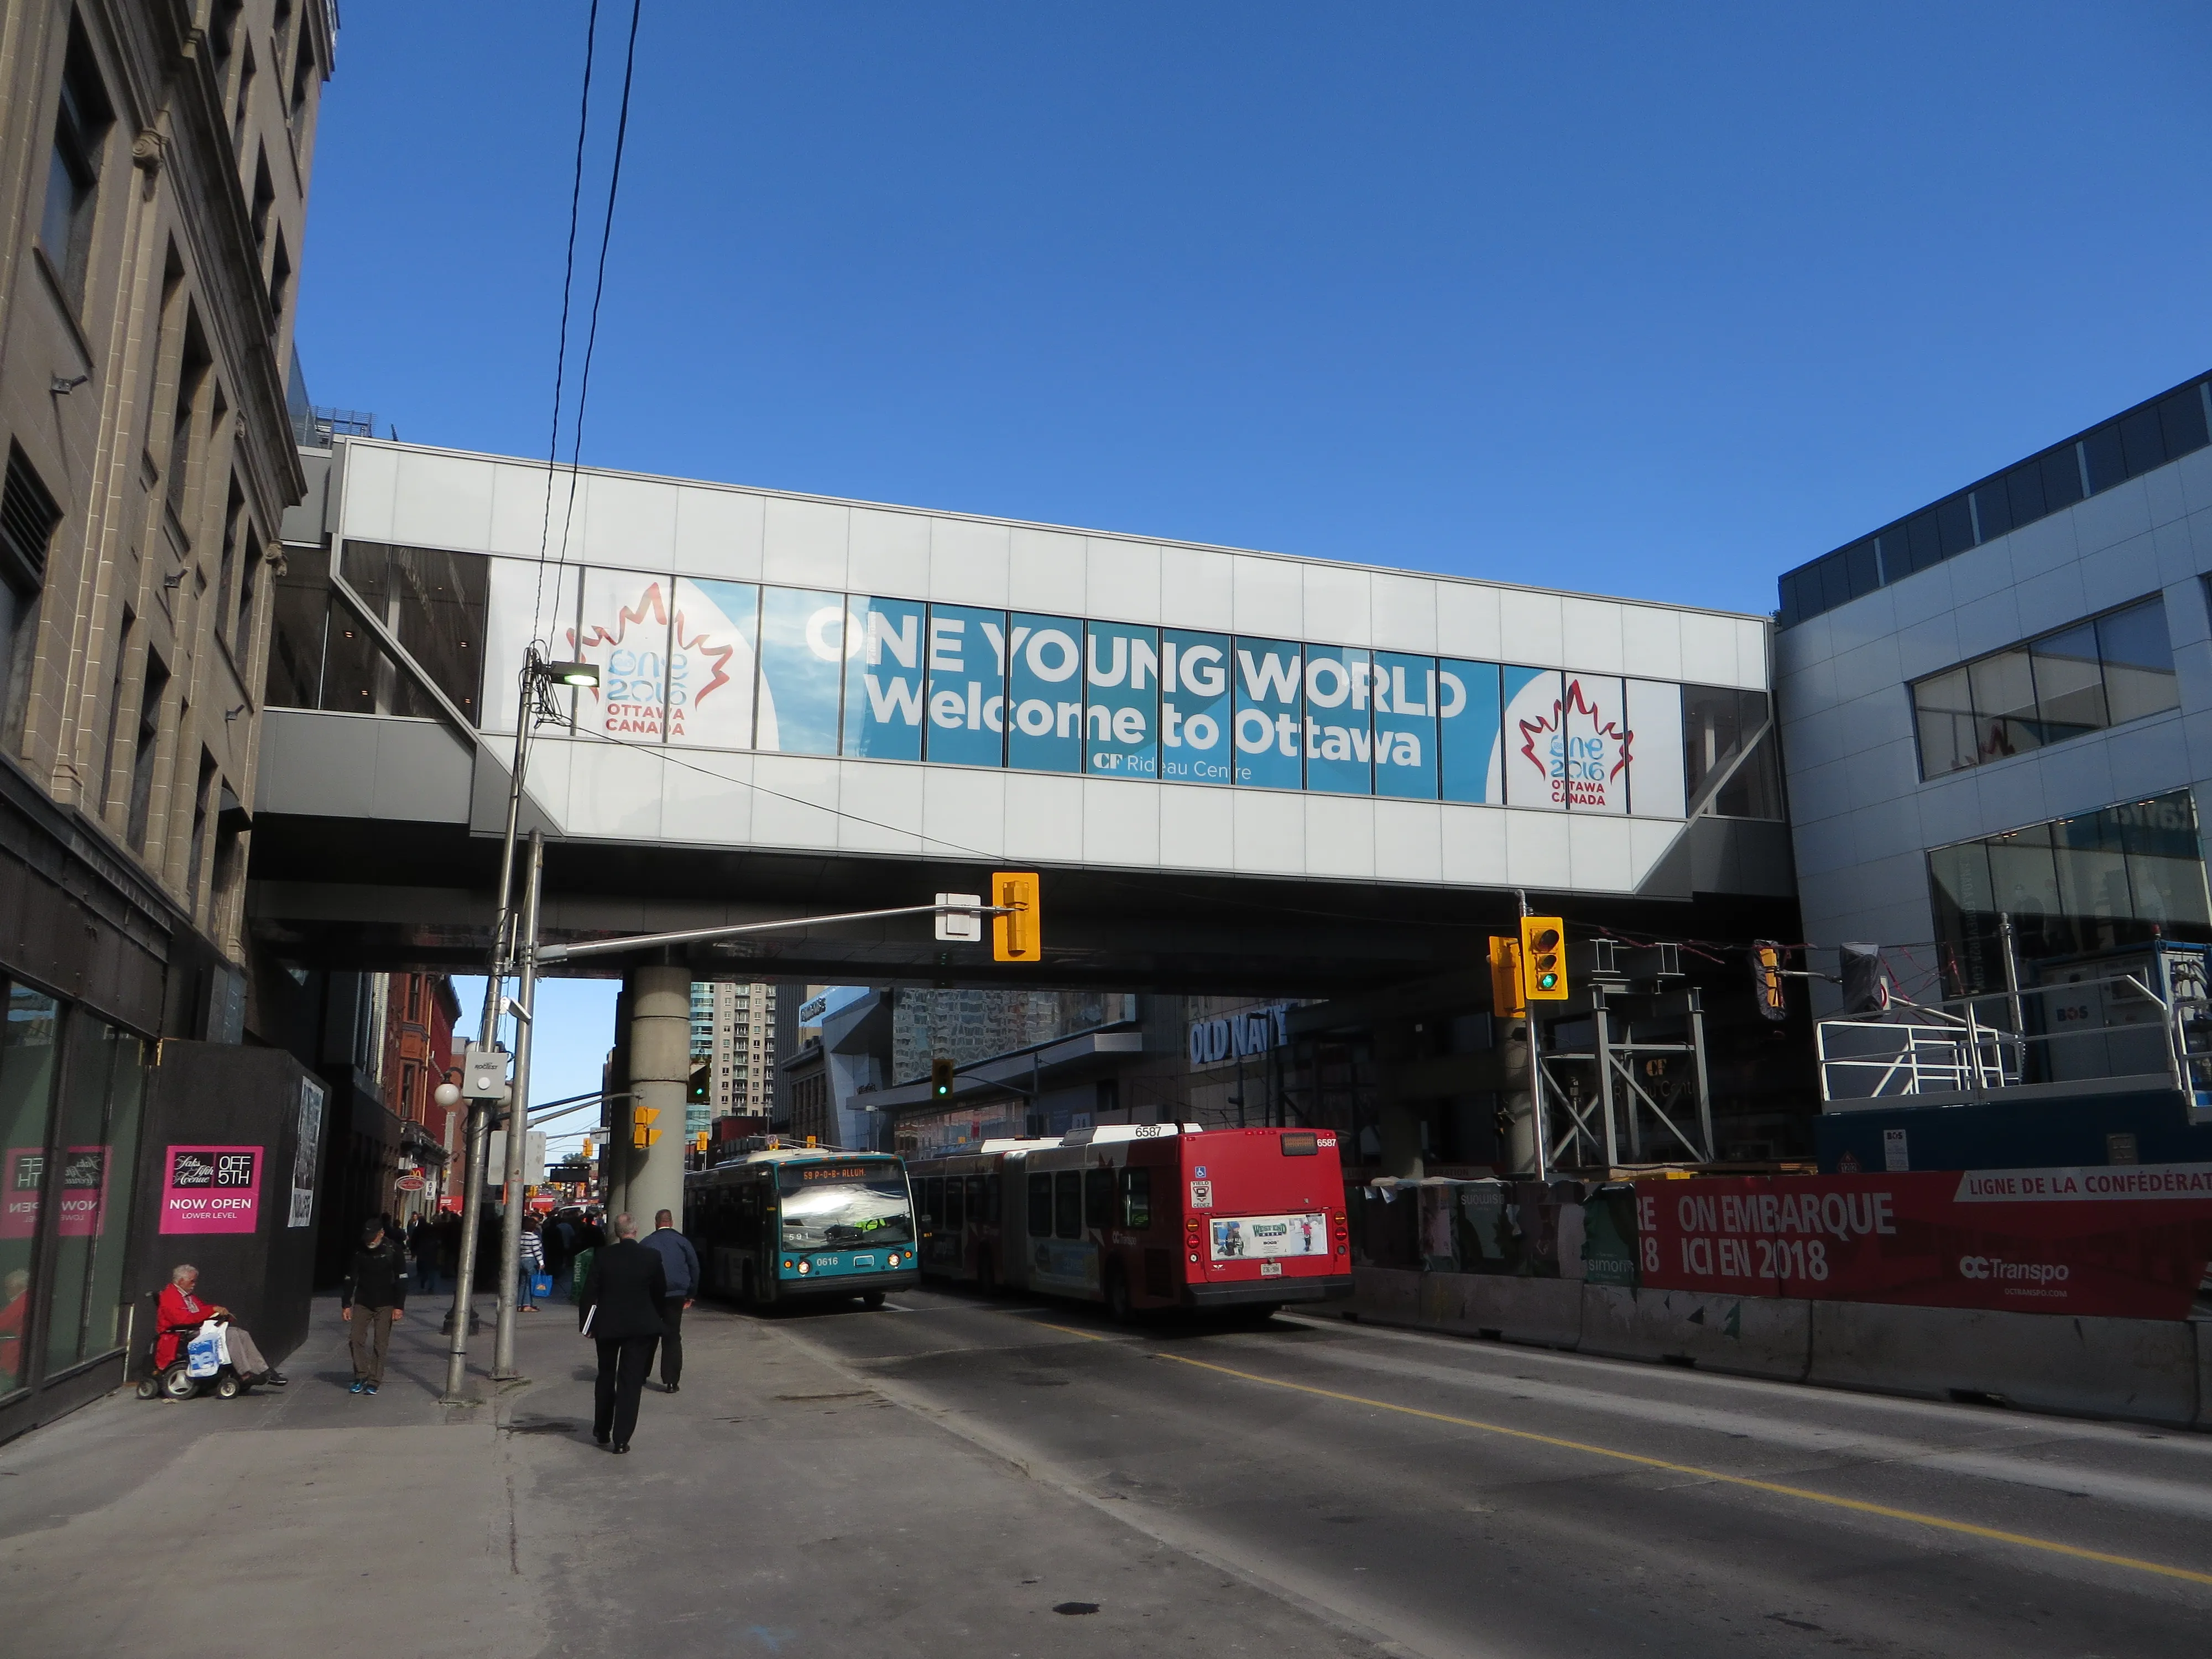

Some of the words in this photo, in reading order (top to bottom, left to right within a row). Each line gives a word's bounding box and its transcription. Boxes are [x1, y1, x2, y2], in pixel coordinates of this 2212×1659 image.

[805, 606, 965, 671] ONE
[980, 622, 1226, 697] YOUNG
[1237, 649, 1467, 718] WORLD
[607, 679, 687, 705] 2016
[863, 674, 1146, 744] Welcome
[1162, 702, 1219, 750] to
[1234, 708, 1422, 767] Ottawa
[1093, 753, 1123, 769] CF
[1128, 755, 1187, 775] Rideau
[1194, 760, 1252, 780] Cenre
[1550, 759, 1604, 781] 2016
[1190, 1019, 1229, 1065] OLD
[1231, 1003, 1288, 1058] NAVY
[1135, 1126, 1162, 1138] 6587
[1317, 1139, 1336, 1147] 6587
[219, 1156, 251, 1171] OFF
[218, 1170, 249, 1185] 5TH
[804, 1171, 812, 1180] 59
[1970, 1178, 2016, 1195] LIGNE
[2022, 1177, 2046, 1194] DE
[2052, 1176, 2078, 1193] LA
[170, 1198, 207, 1209] NOW
[211, 1198, 252, 1209] OPEN
[1678, 1195, 1717, 1232] ON
[1721, 1192, 1897, 1242] EMBARQUE
[1253, 1223, 1272, 1238] WEST
[1273, 1223, 1287, 1235] END
[816, 1257, 838, 1266] 0616
[1681, 1237, 1714, 1275] ICI
[1718, 1238, 1752, 1277] EN
[1755, 1239, 1829, 1281] 2018
[573, 1260, 582, 1282] metr
[1959, 1255, 1990, 1279] OC
[1990, 1258, 2069, 1285] Transpo
[2004, 1287, 2068, 1298] OCTRANSPO.COM
